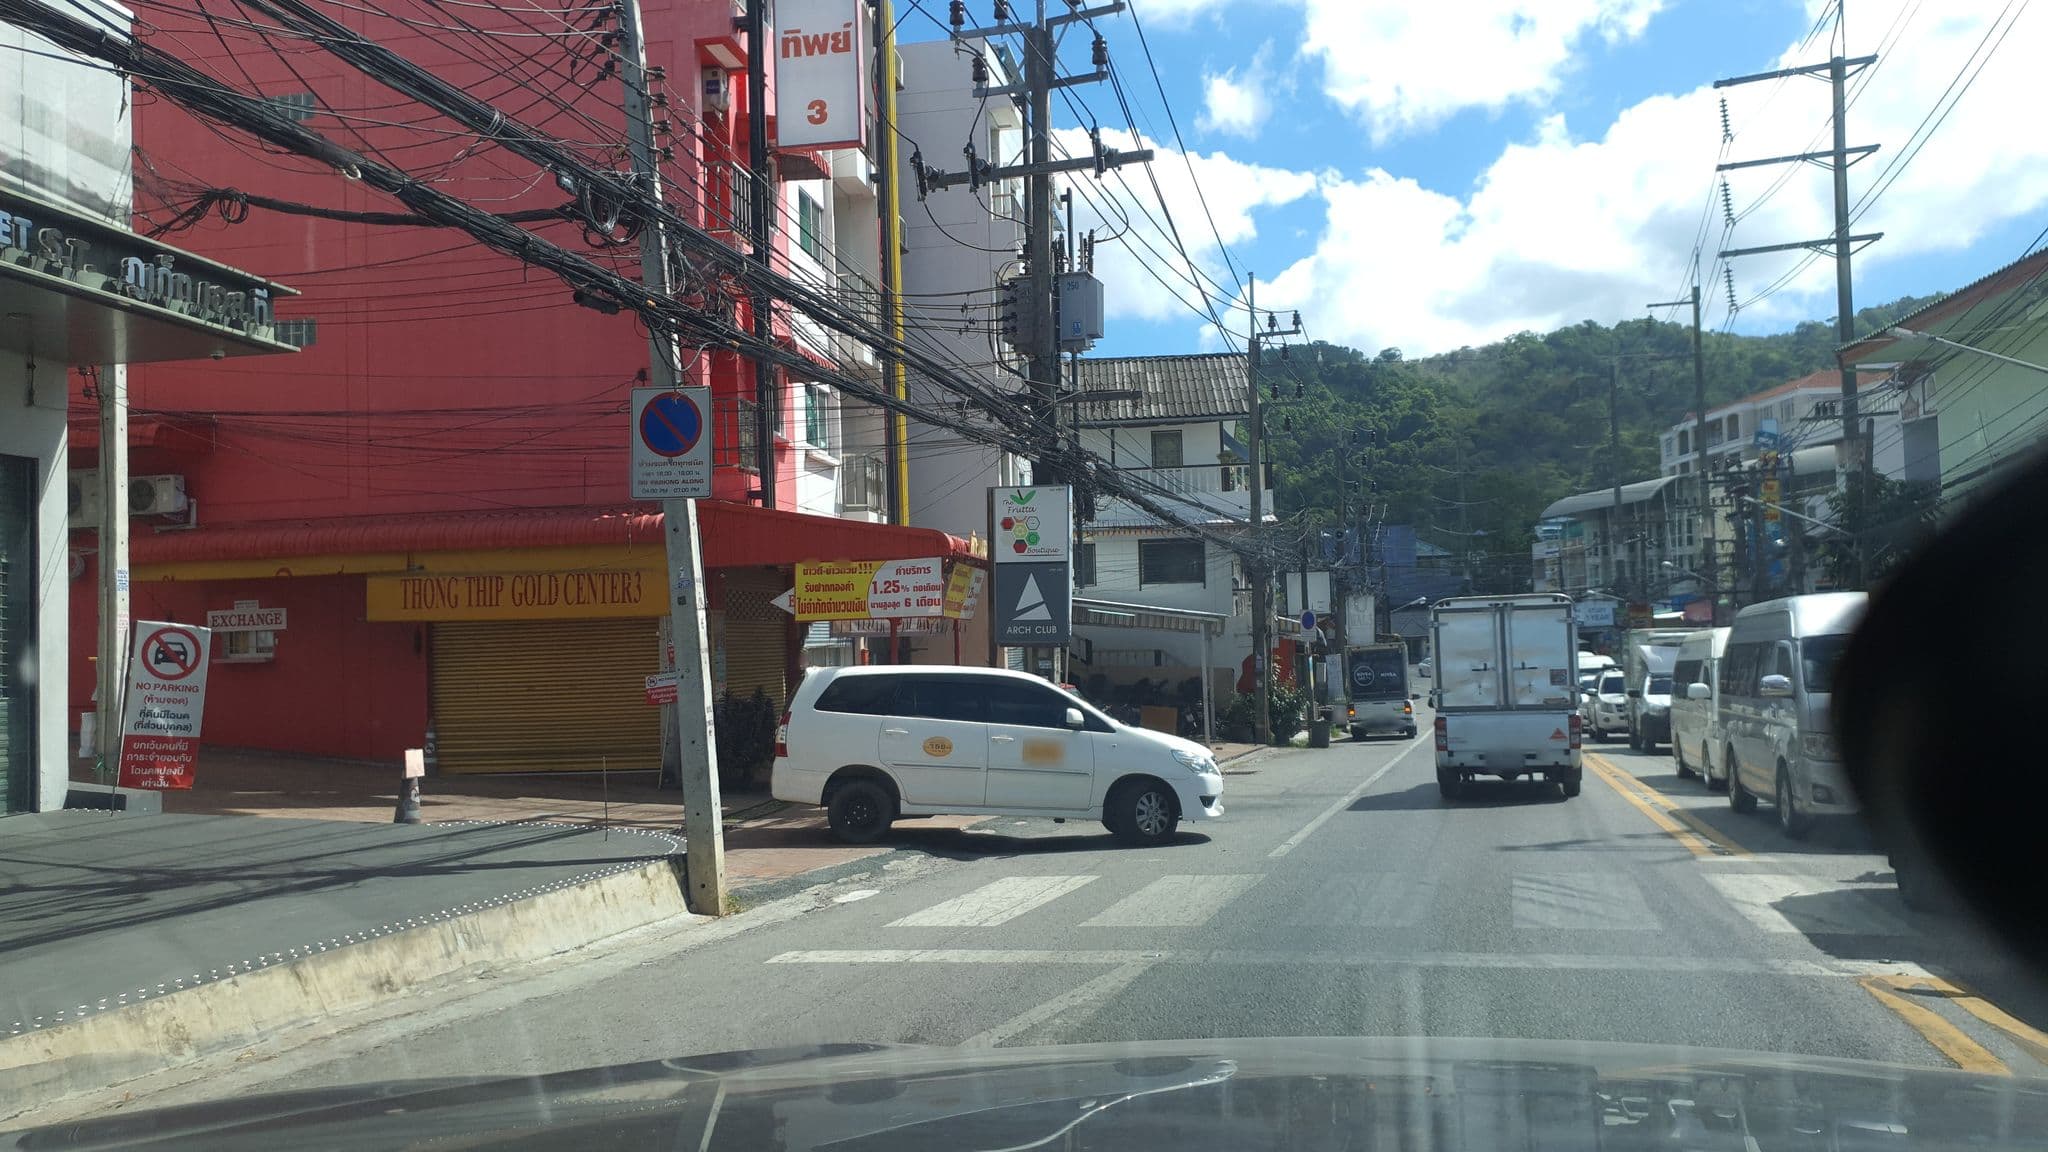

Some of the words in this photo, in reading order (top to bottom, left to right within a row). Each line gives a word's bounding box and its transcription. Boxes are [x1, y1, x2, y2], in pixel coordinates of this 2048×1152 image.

[781, 22, 852, 59] ทิพย์
[807, 99, 828, 125] 3
[895, 565, 932, 576] ค่าบริการ
[401, 575, 459, 609] THONG
[464, 575, 504, 608] THIP
[511, 573, 560, 607] GOLD
[804, 580, 855, 593] รับฝากทองคำ
[904, 597, 912, 607] 6
[916, 595, 941, 607] เดือน
[210, 612, 283, 627] EXCHANGE
[1006, 625, 1032, 634] ARCH
[1035, 625, 1058, 634] CLUB
[135, 682, 151, 690] NO
[154, 683, 200, 693] PARKING
[144, 694, 189, 706] (ห้ามจอด)
[133, 720, 193, 733] (ที่ส่วนบุคคล)
[133, 739, 189, 751] ยกเว้นคนที่มี
[126, 752, 192, 763] ภาระจำยอมกับ
[141, 774, 170, 787] เท่านั้น
